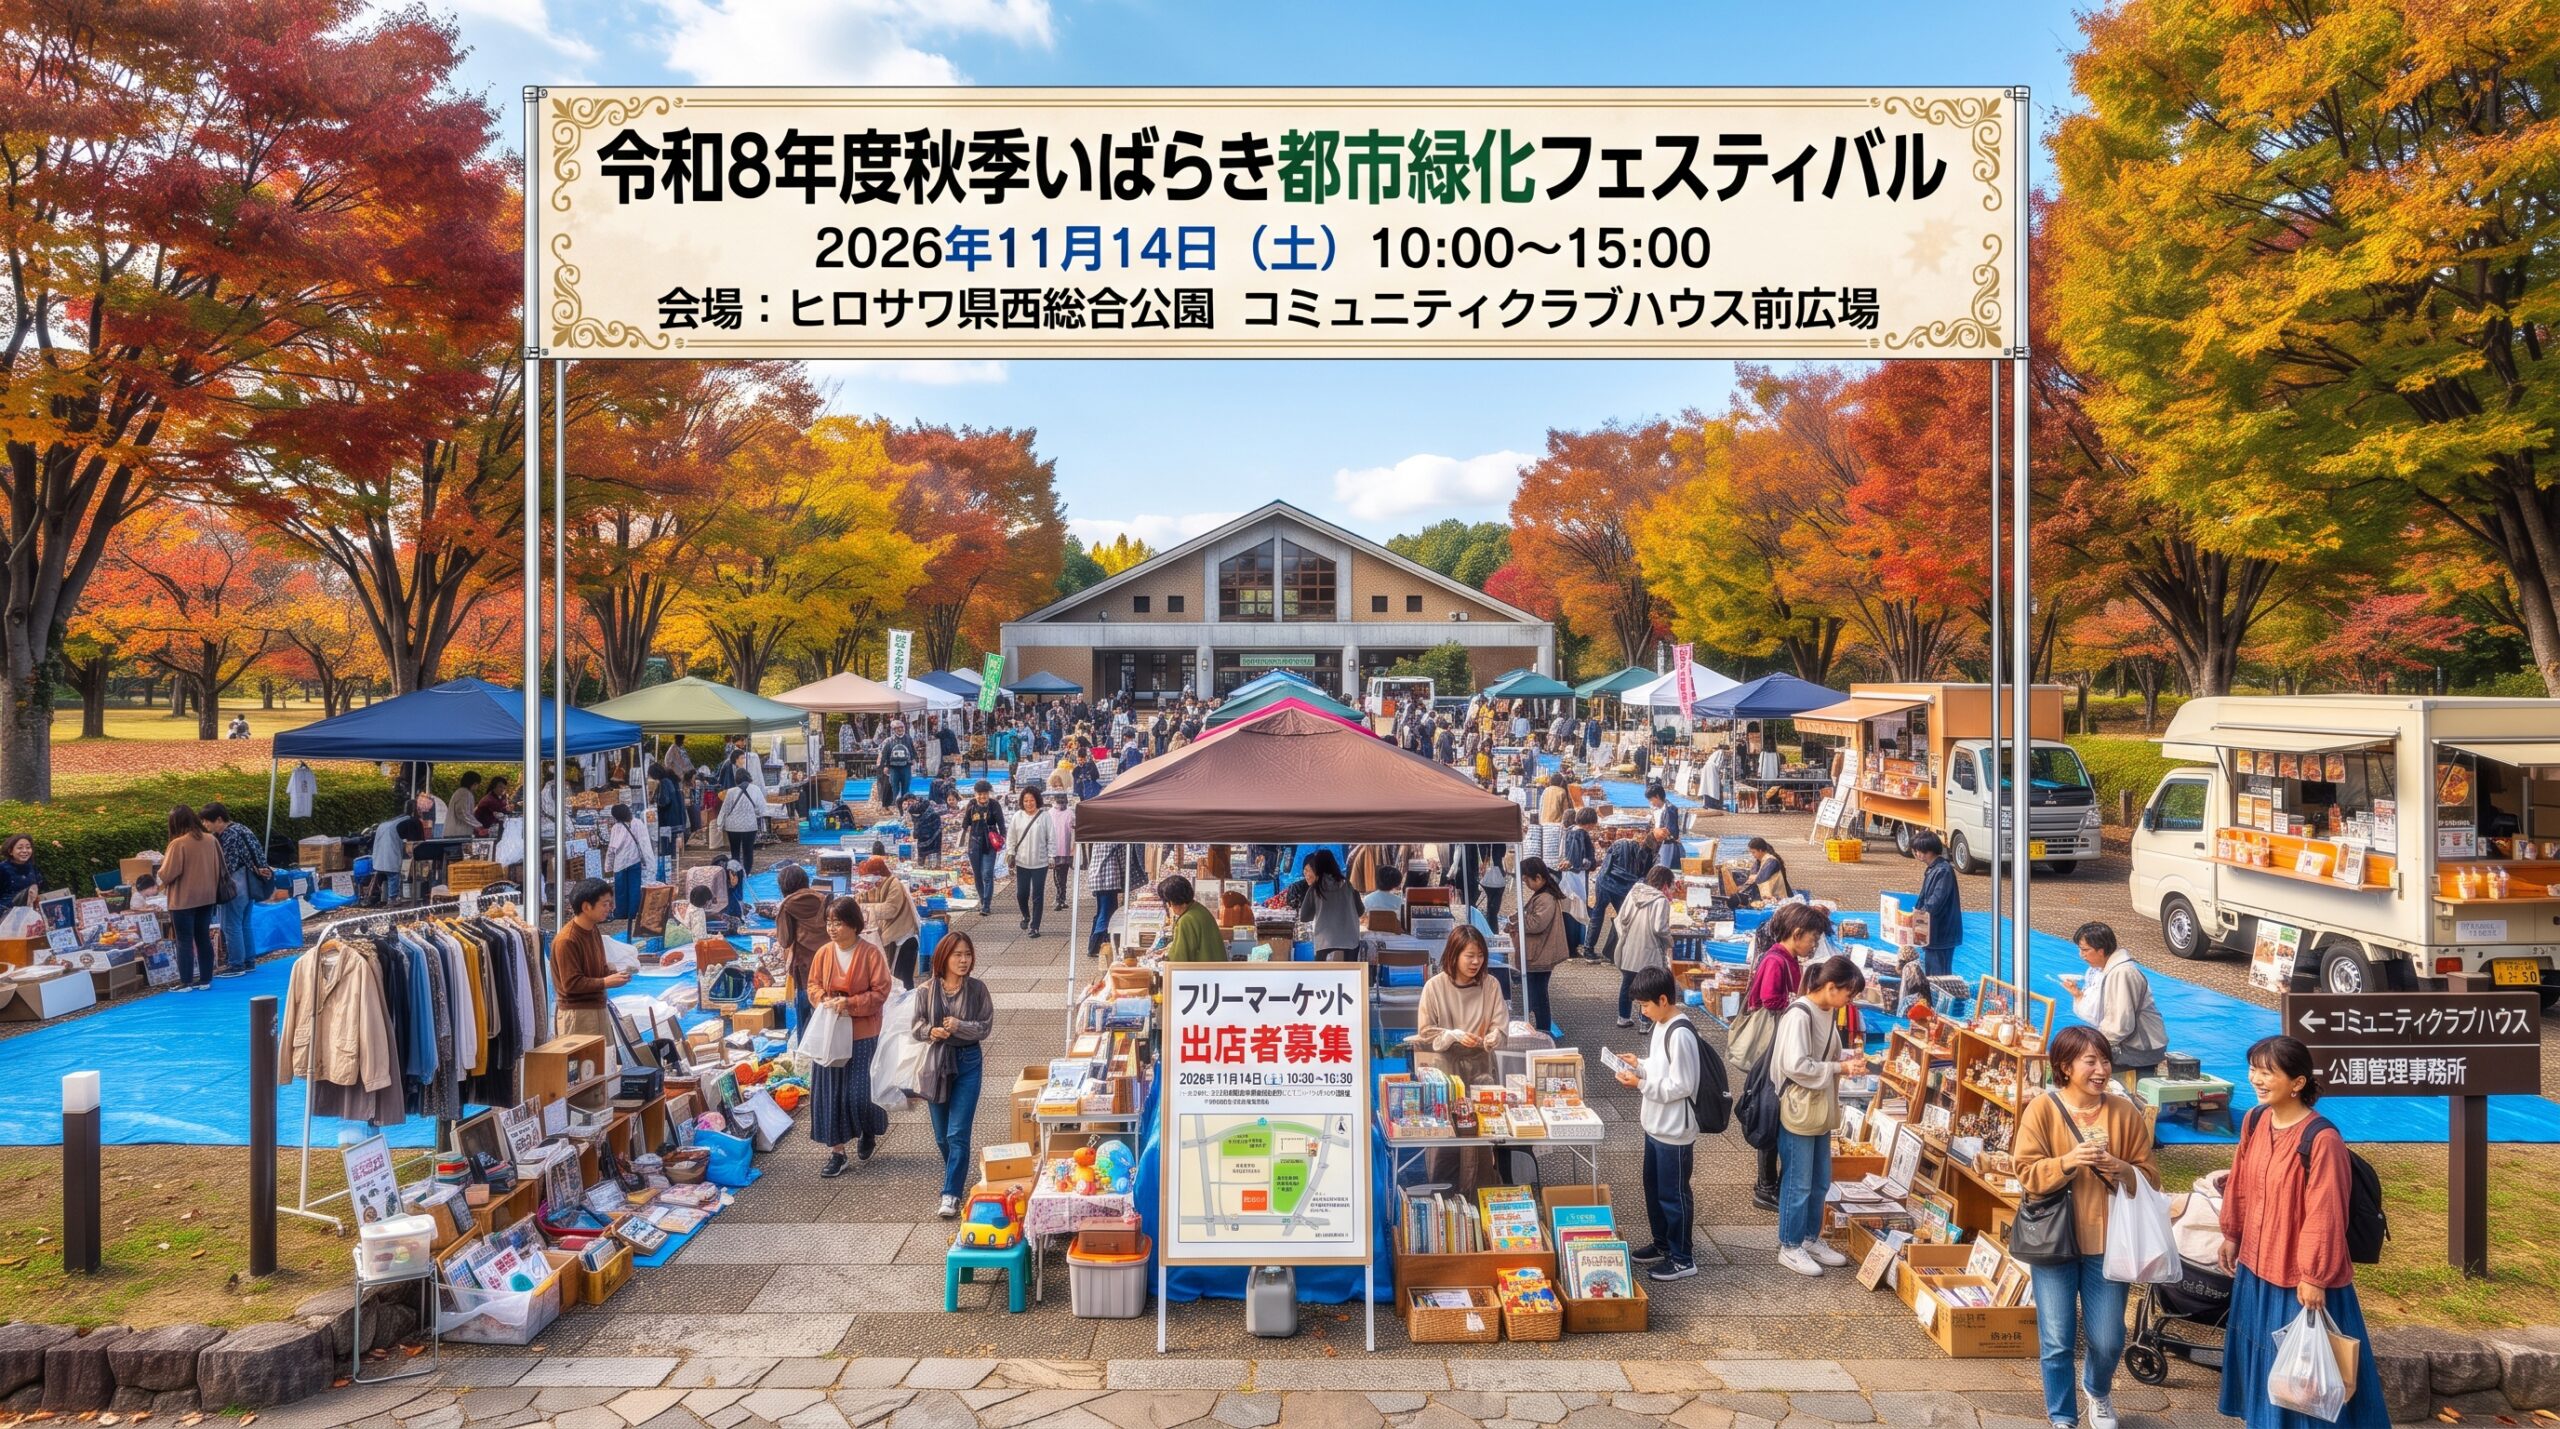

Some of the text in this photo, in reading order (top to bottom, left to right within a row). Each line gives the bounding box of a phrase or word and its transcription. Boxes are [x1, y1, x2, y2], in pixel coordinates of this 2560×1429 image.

[596, 125, 1948, 206] 令和8年度秋季いばらき都市緑化フェスティバル
[1371, 226, 1711, 270] 10:00～15:00
[657, 286, 1881, 332] 会場：ヒロサワ県西総合公園 コミュニティクラブハウス前広場
[1178, 982, 1354, 1017] フリーマーケット
[2330, 1006, 2531, 1036] コミュニティクラブハウス
[1180, 1023, 1354, 1065] 出店者募集
[2328, 1056, 2467, 1086] 公園管理事務所
